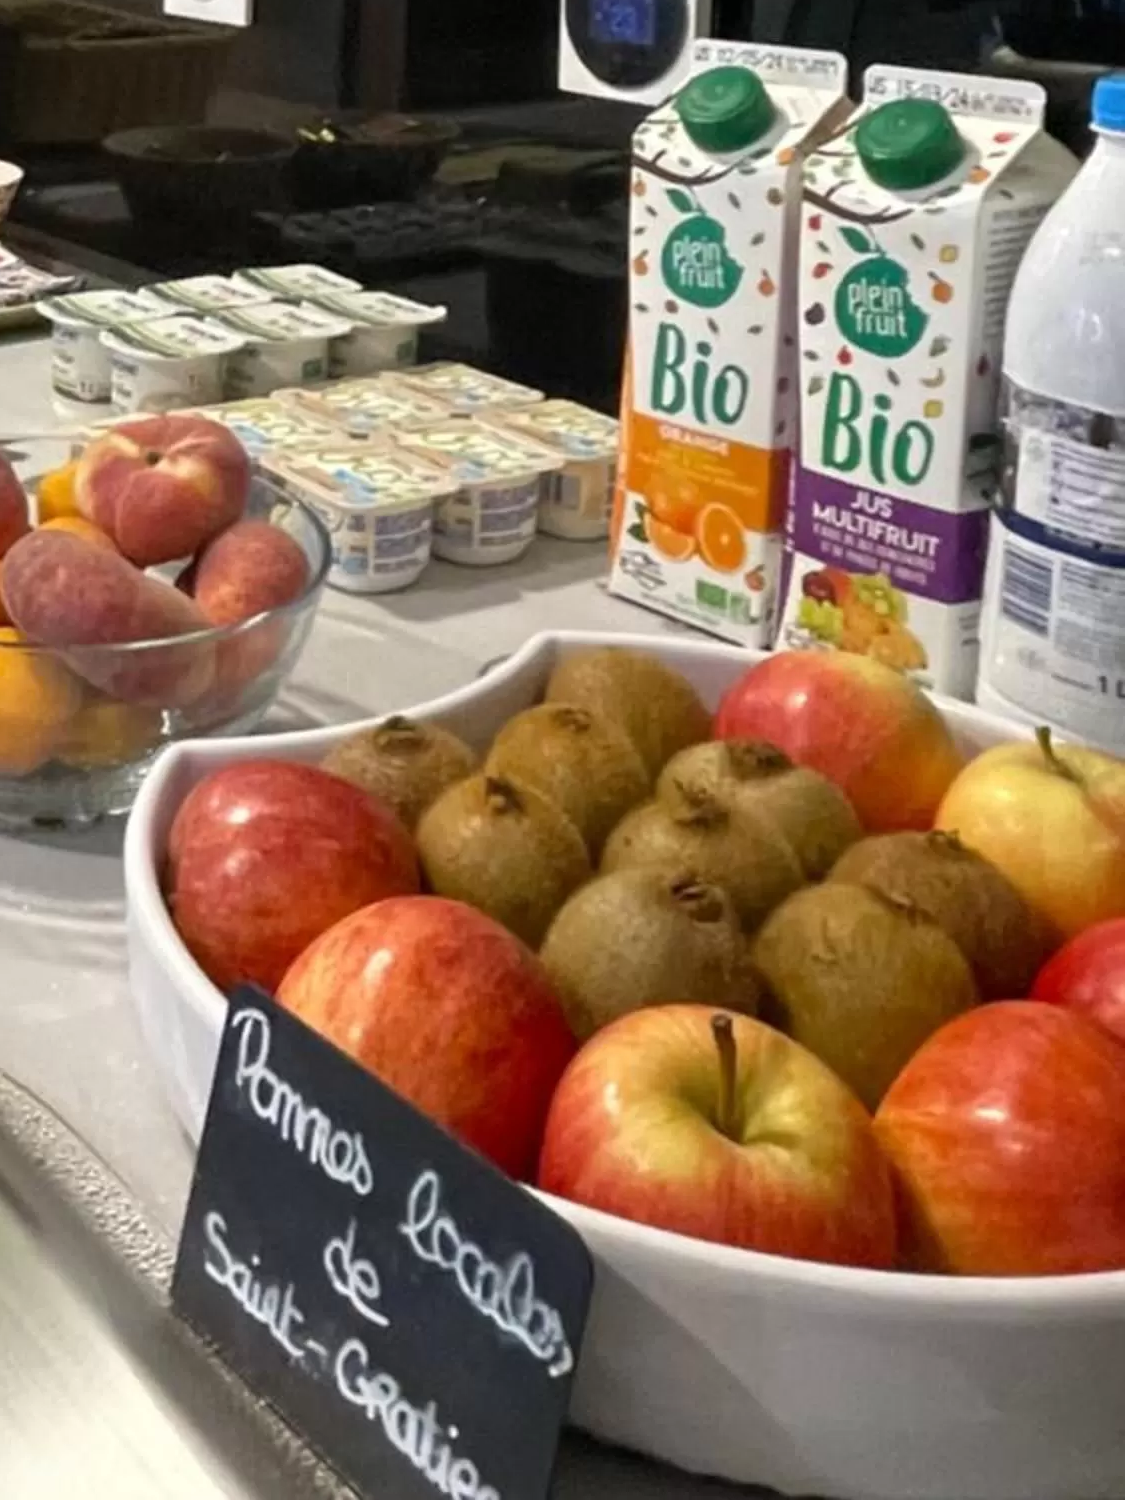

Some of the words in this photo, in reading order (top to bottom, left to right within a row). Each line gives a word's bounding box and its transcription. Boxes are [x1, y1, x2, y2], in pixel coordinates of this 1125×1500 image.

[671, 235, 722, 270] plein
[678, 263, 727, 289] fruit
[846, 277, 904, 315] plein
[854, 306, 908, 338] fruit
[650, 320, 750, 426] Bio
[821, 370, 935, 487] Bio
[850, 490, 893, 519] JUS
[812, 500, 940, 557] MULTIFRUIT
[323, 1216, 390, 1327] de
